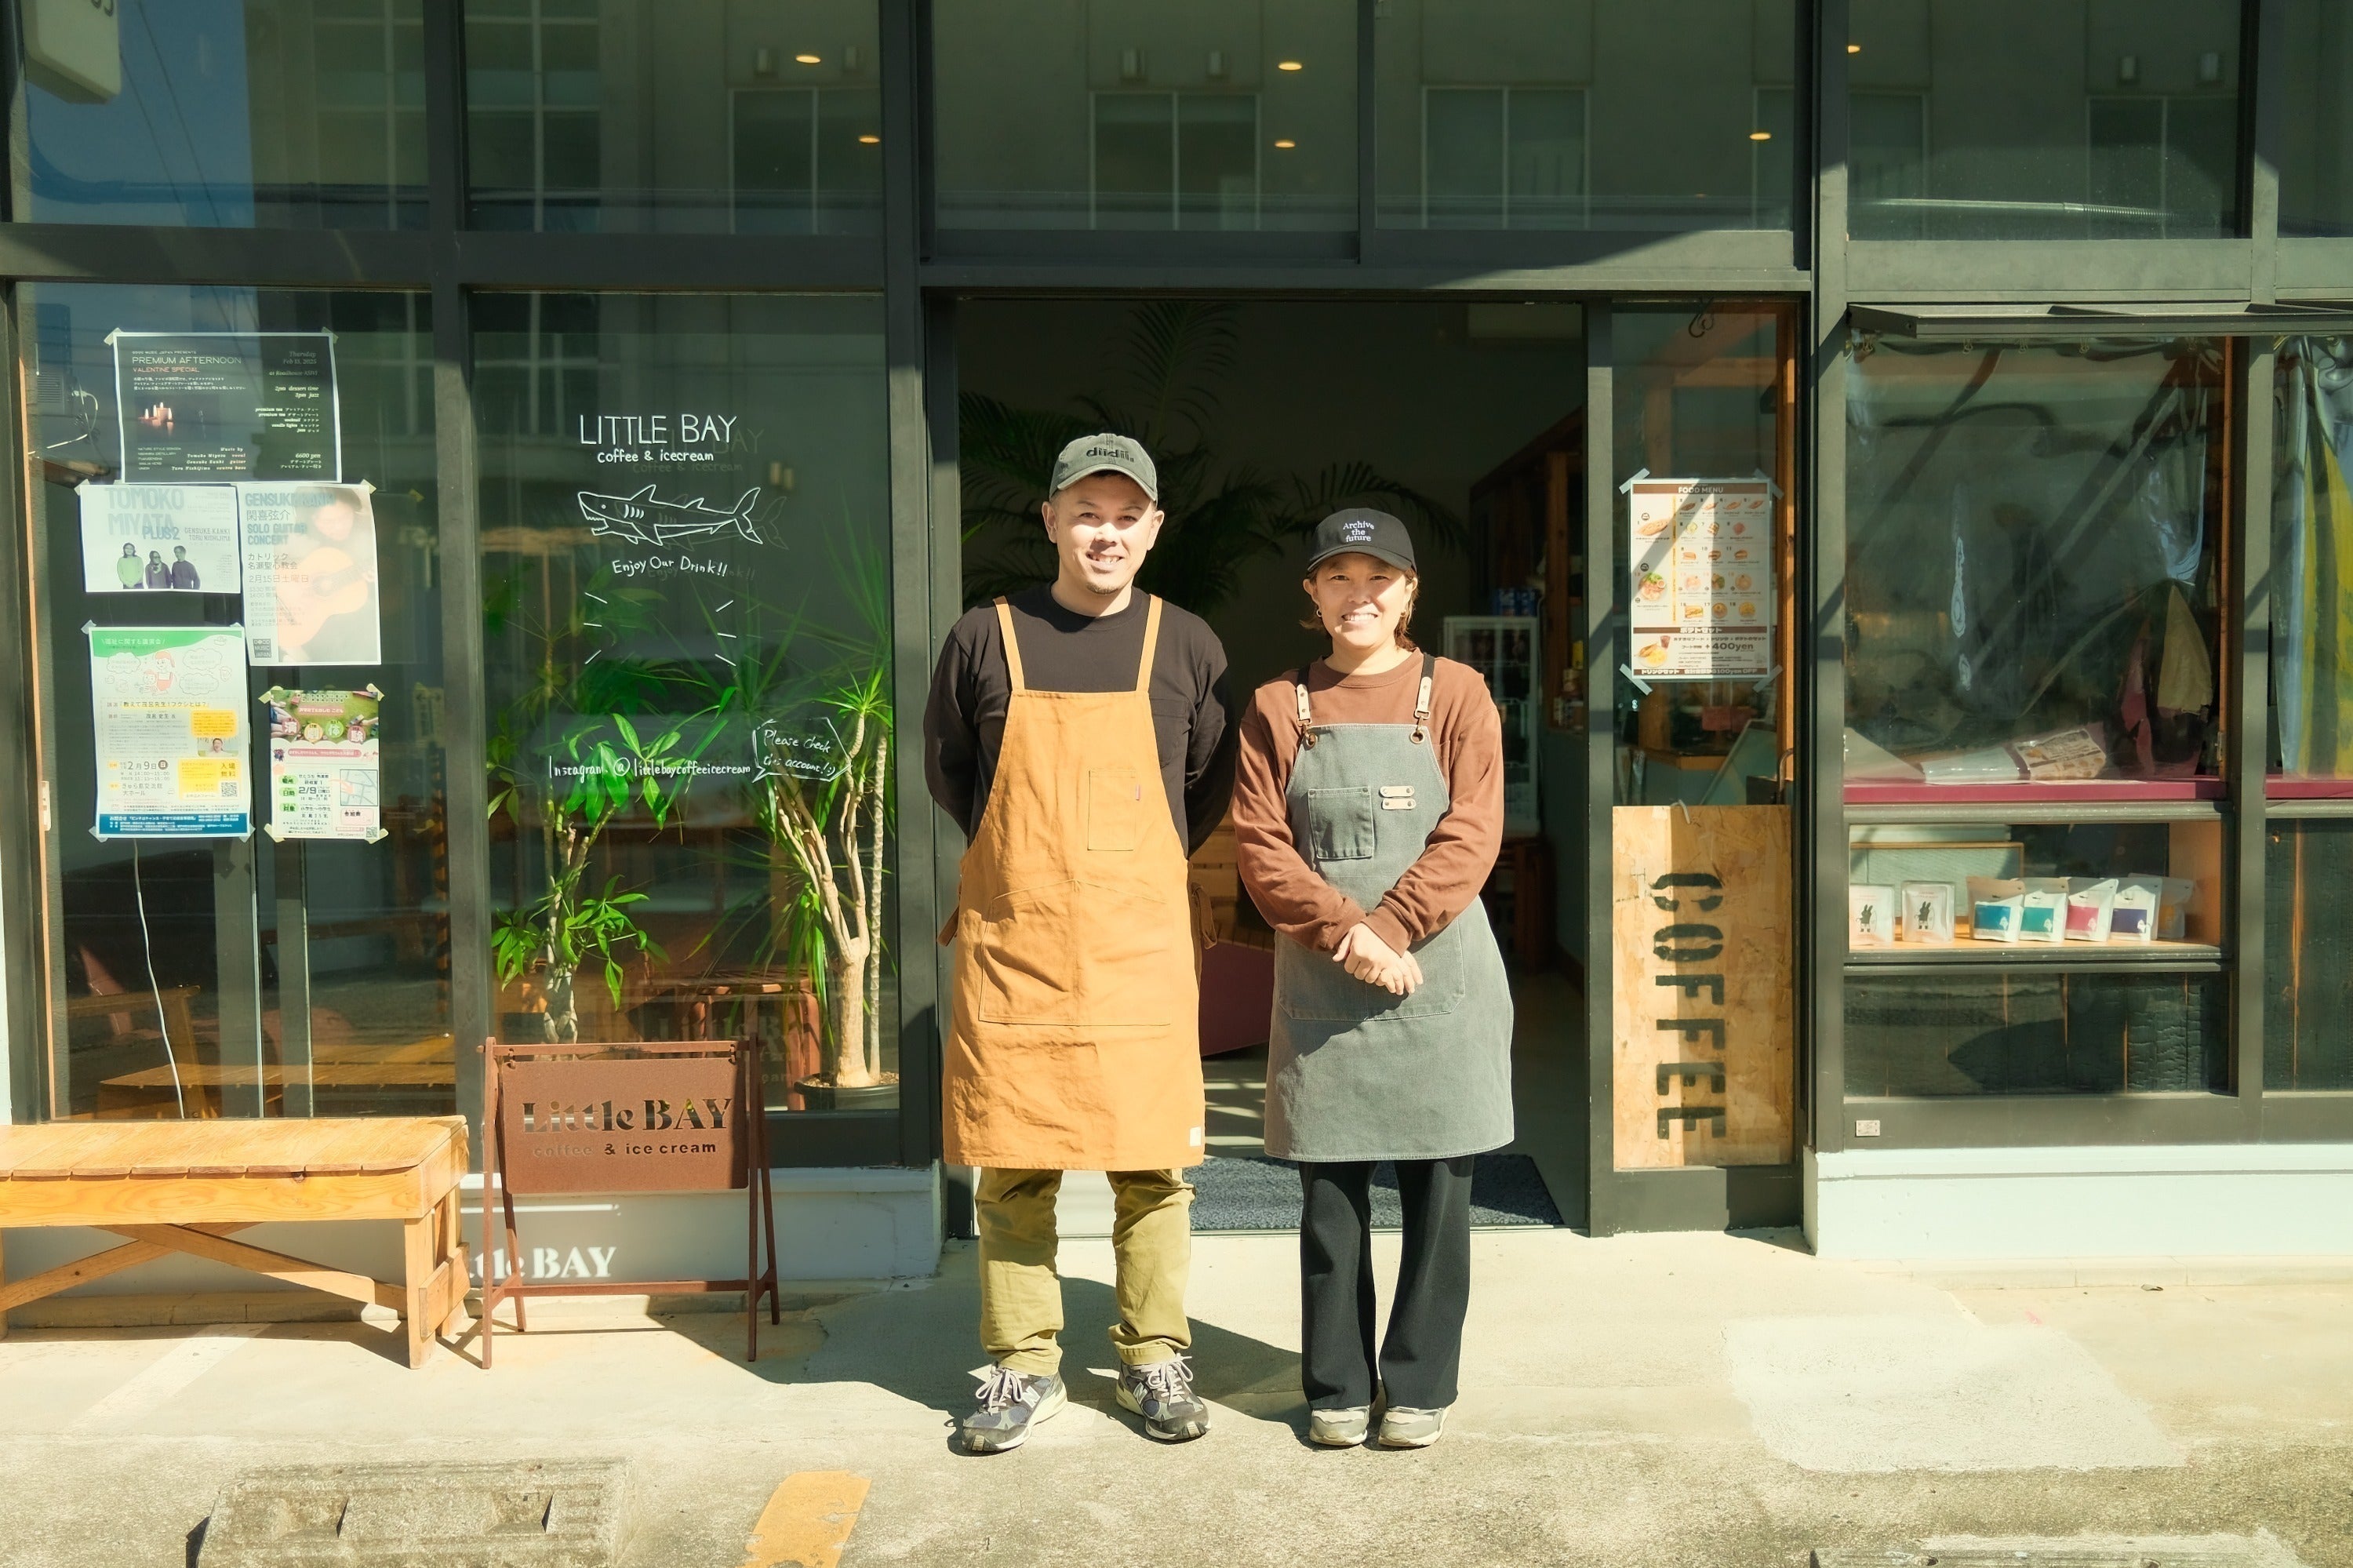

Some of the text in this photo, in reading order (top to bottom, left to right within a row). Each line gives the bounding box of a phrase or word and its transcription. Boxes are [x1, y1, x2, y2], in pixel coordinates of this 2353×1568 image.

[132, 356, 242, 365] PREMIUM AFTERNOON
[580, 414, 737, 446] LITTLE BAY
[598, 449, 714, 463] coffee & icecream
[105, 487, 185, 510] TOMOKO
[107, 513, 175, 535] MIYATA
[247, 522, 307, 534] SOLO GUITAR
[1343, 520, 1375, 530] Archive
[248, 535, 289, 545] CONCERT
[248, 552, 289, 561] カトリック
[248, 562, 299, 571] 名瀬聖心教会
[613, 555, 728, 577] Enjoy Our Drink!!
[249, 574, 310, 584] 2月15日土曜日
[1712, 642, 1754, 652] 400yen
[764, 729, 799, 747] Please
[1650, 873, 1727, 1140] COFFEE
[522, 1097, 732, 1134] Little BAY
[533, 1141, 717, 1159] coffee & ice cream
[532, 1246, 617, 1279] BAY
